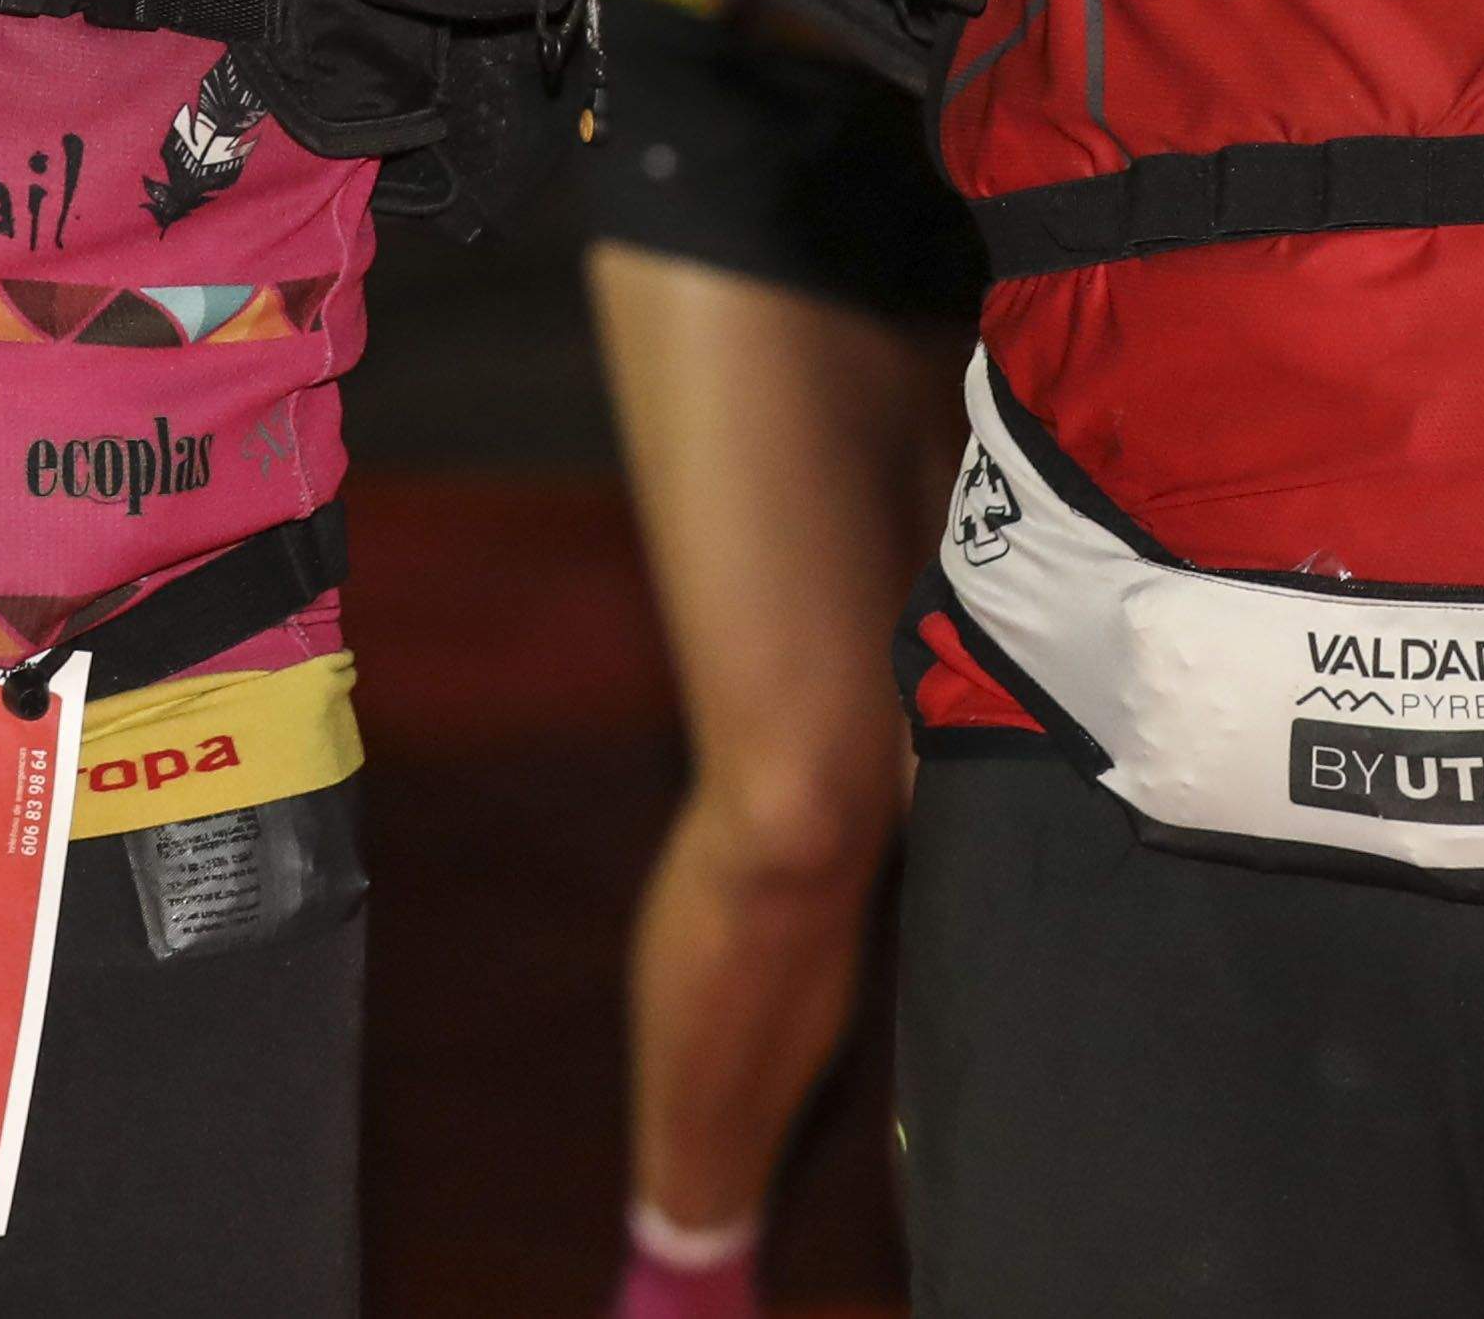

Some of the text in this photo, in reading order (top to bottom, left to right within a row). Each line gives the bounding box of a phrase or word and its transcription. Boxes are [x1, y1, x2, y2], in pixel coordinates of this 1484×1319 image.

[24, 416, 215, 516] ecoplas
[20, 748, 49, 857] 606 83 98 64
[1310, 745, 1385, 795] BY
